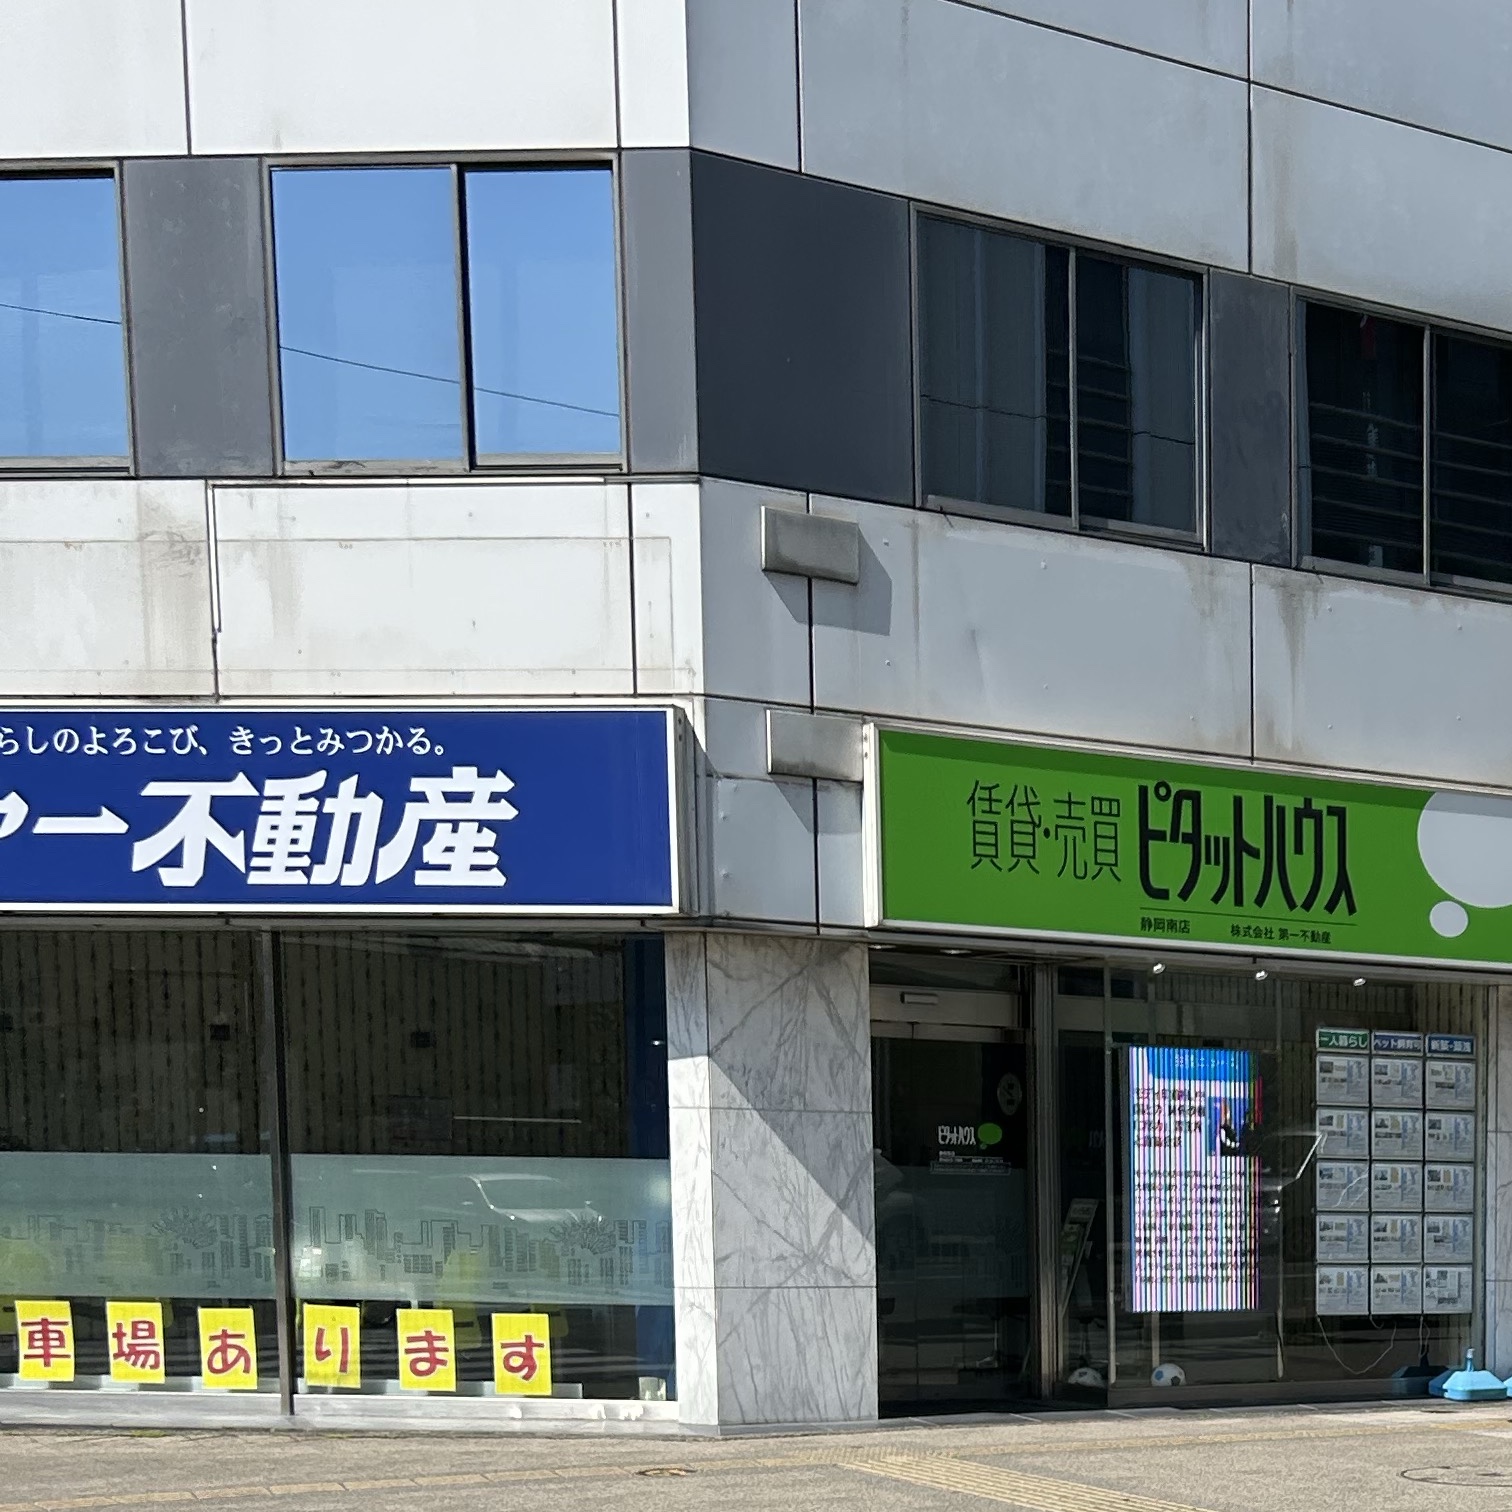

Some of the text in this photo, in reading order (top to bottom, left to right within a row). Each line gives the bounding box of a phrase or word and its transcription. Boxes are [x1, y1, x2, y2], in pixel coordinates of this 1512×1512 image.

[967, 779, 1358, 916] 賃貸・売買 ピタットハウス
[1140, 916, 1191, 934] 静岡南店
[20, 1316, 546, 1382] 車場あります
